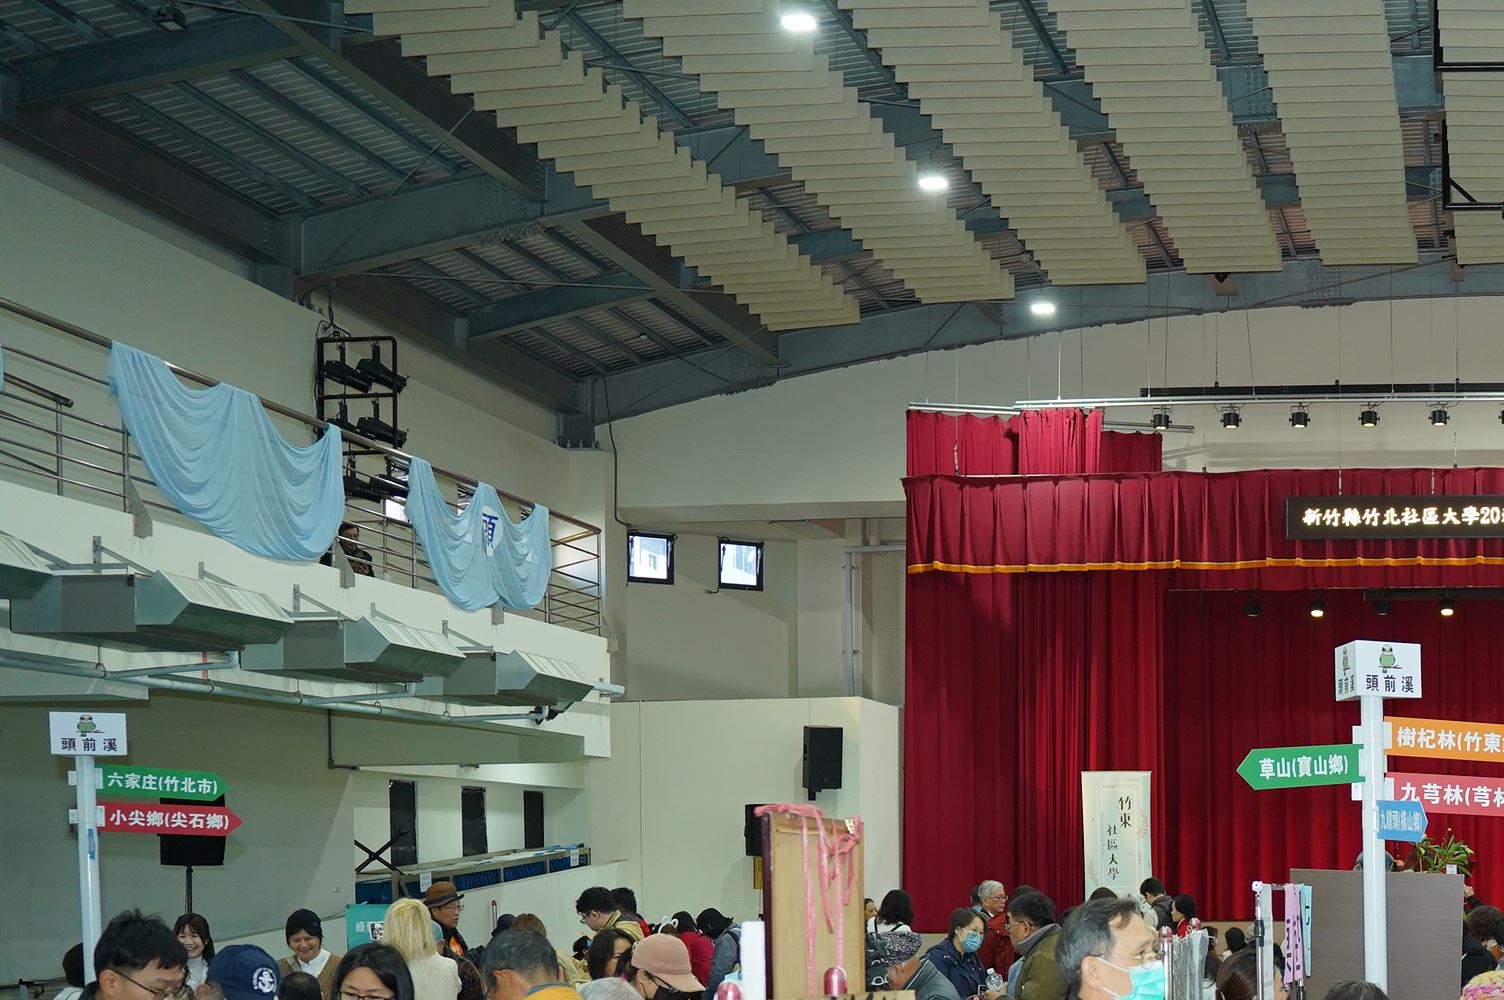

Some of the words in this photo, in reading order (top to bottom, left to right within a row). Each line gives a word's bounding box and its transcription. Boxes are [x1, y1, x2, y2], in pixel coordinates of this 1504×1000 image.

[1366, 674, 1414, 693] 頭前溪
[61, 737, 118, 752] 頭前溪
[1259, 754, 1349, 779] 草山(寶山鄉)
[107, 772, 218, 795] 六家庄(竹北市)
[110, 809, 229, 830] 小尖鄉(尖石鄉)
[1119, 796, 1132, 829] 竹東
